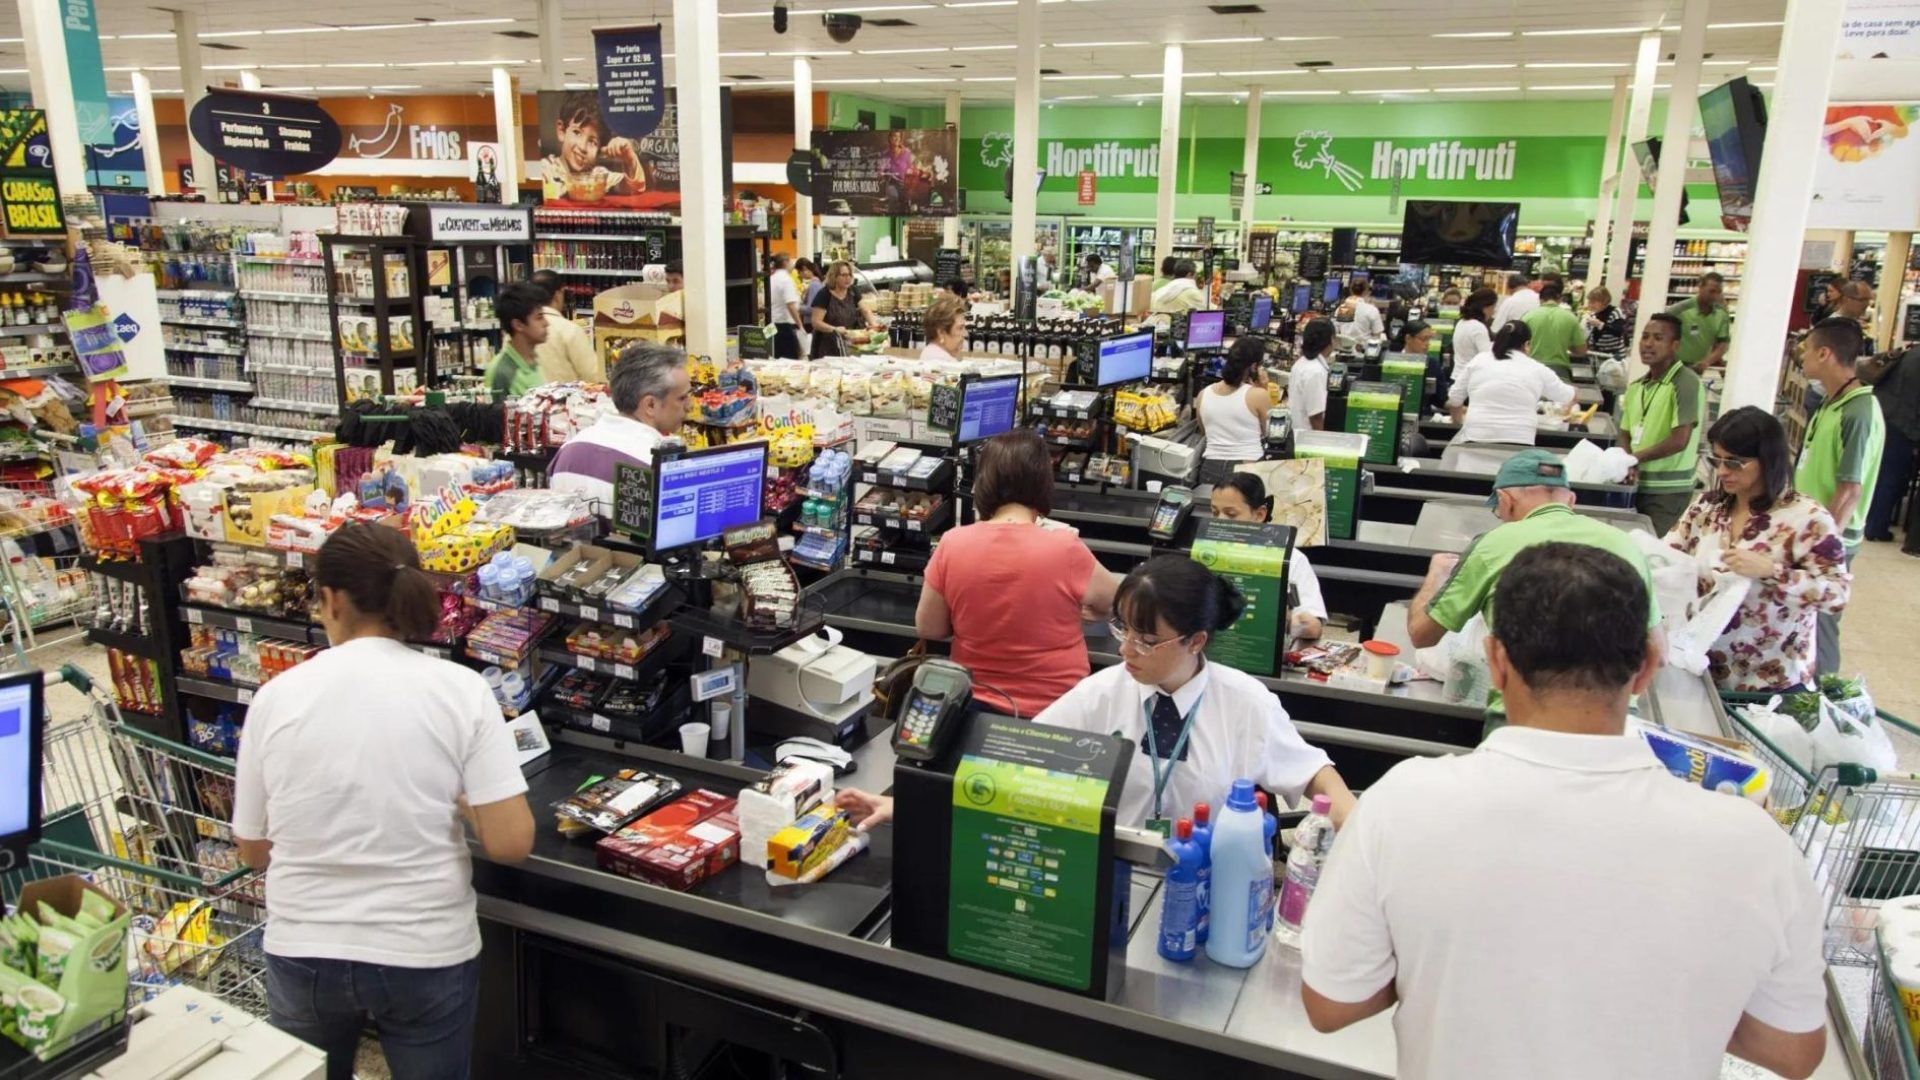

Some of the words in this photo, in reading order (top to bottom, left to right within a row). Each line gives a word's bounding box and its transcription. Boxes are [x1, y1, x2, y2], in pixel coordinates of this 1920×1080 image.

[262, 102, 269, 114] 3
[409, 125, 460, 160] Frios
[1047, 141, 1159, 177] Hortifrut
[1371, 140, 1517, 180] Hortifruti
[3, 181, 41, 201] CARAS
[8, 204, 62, 228] BRASIL
[115, 324, 138, 333] taeq
[1685, 747, 1706, 783] nob
